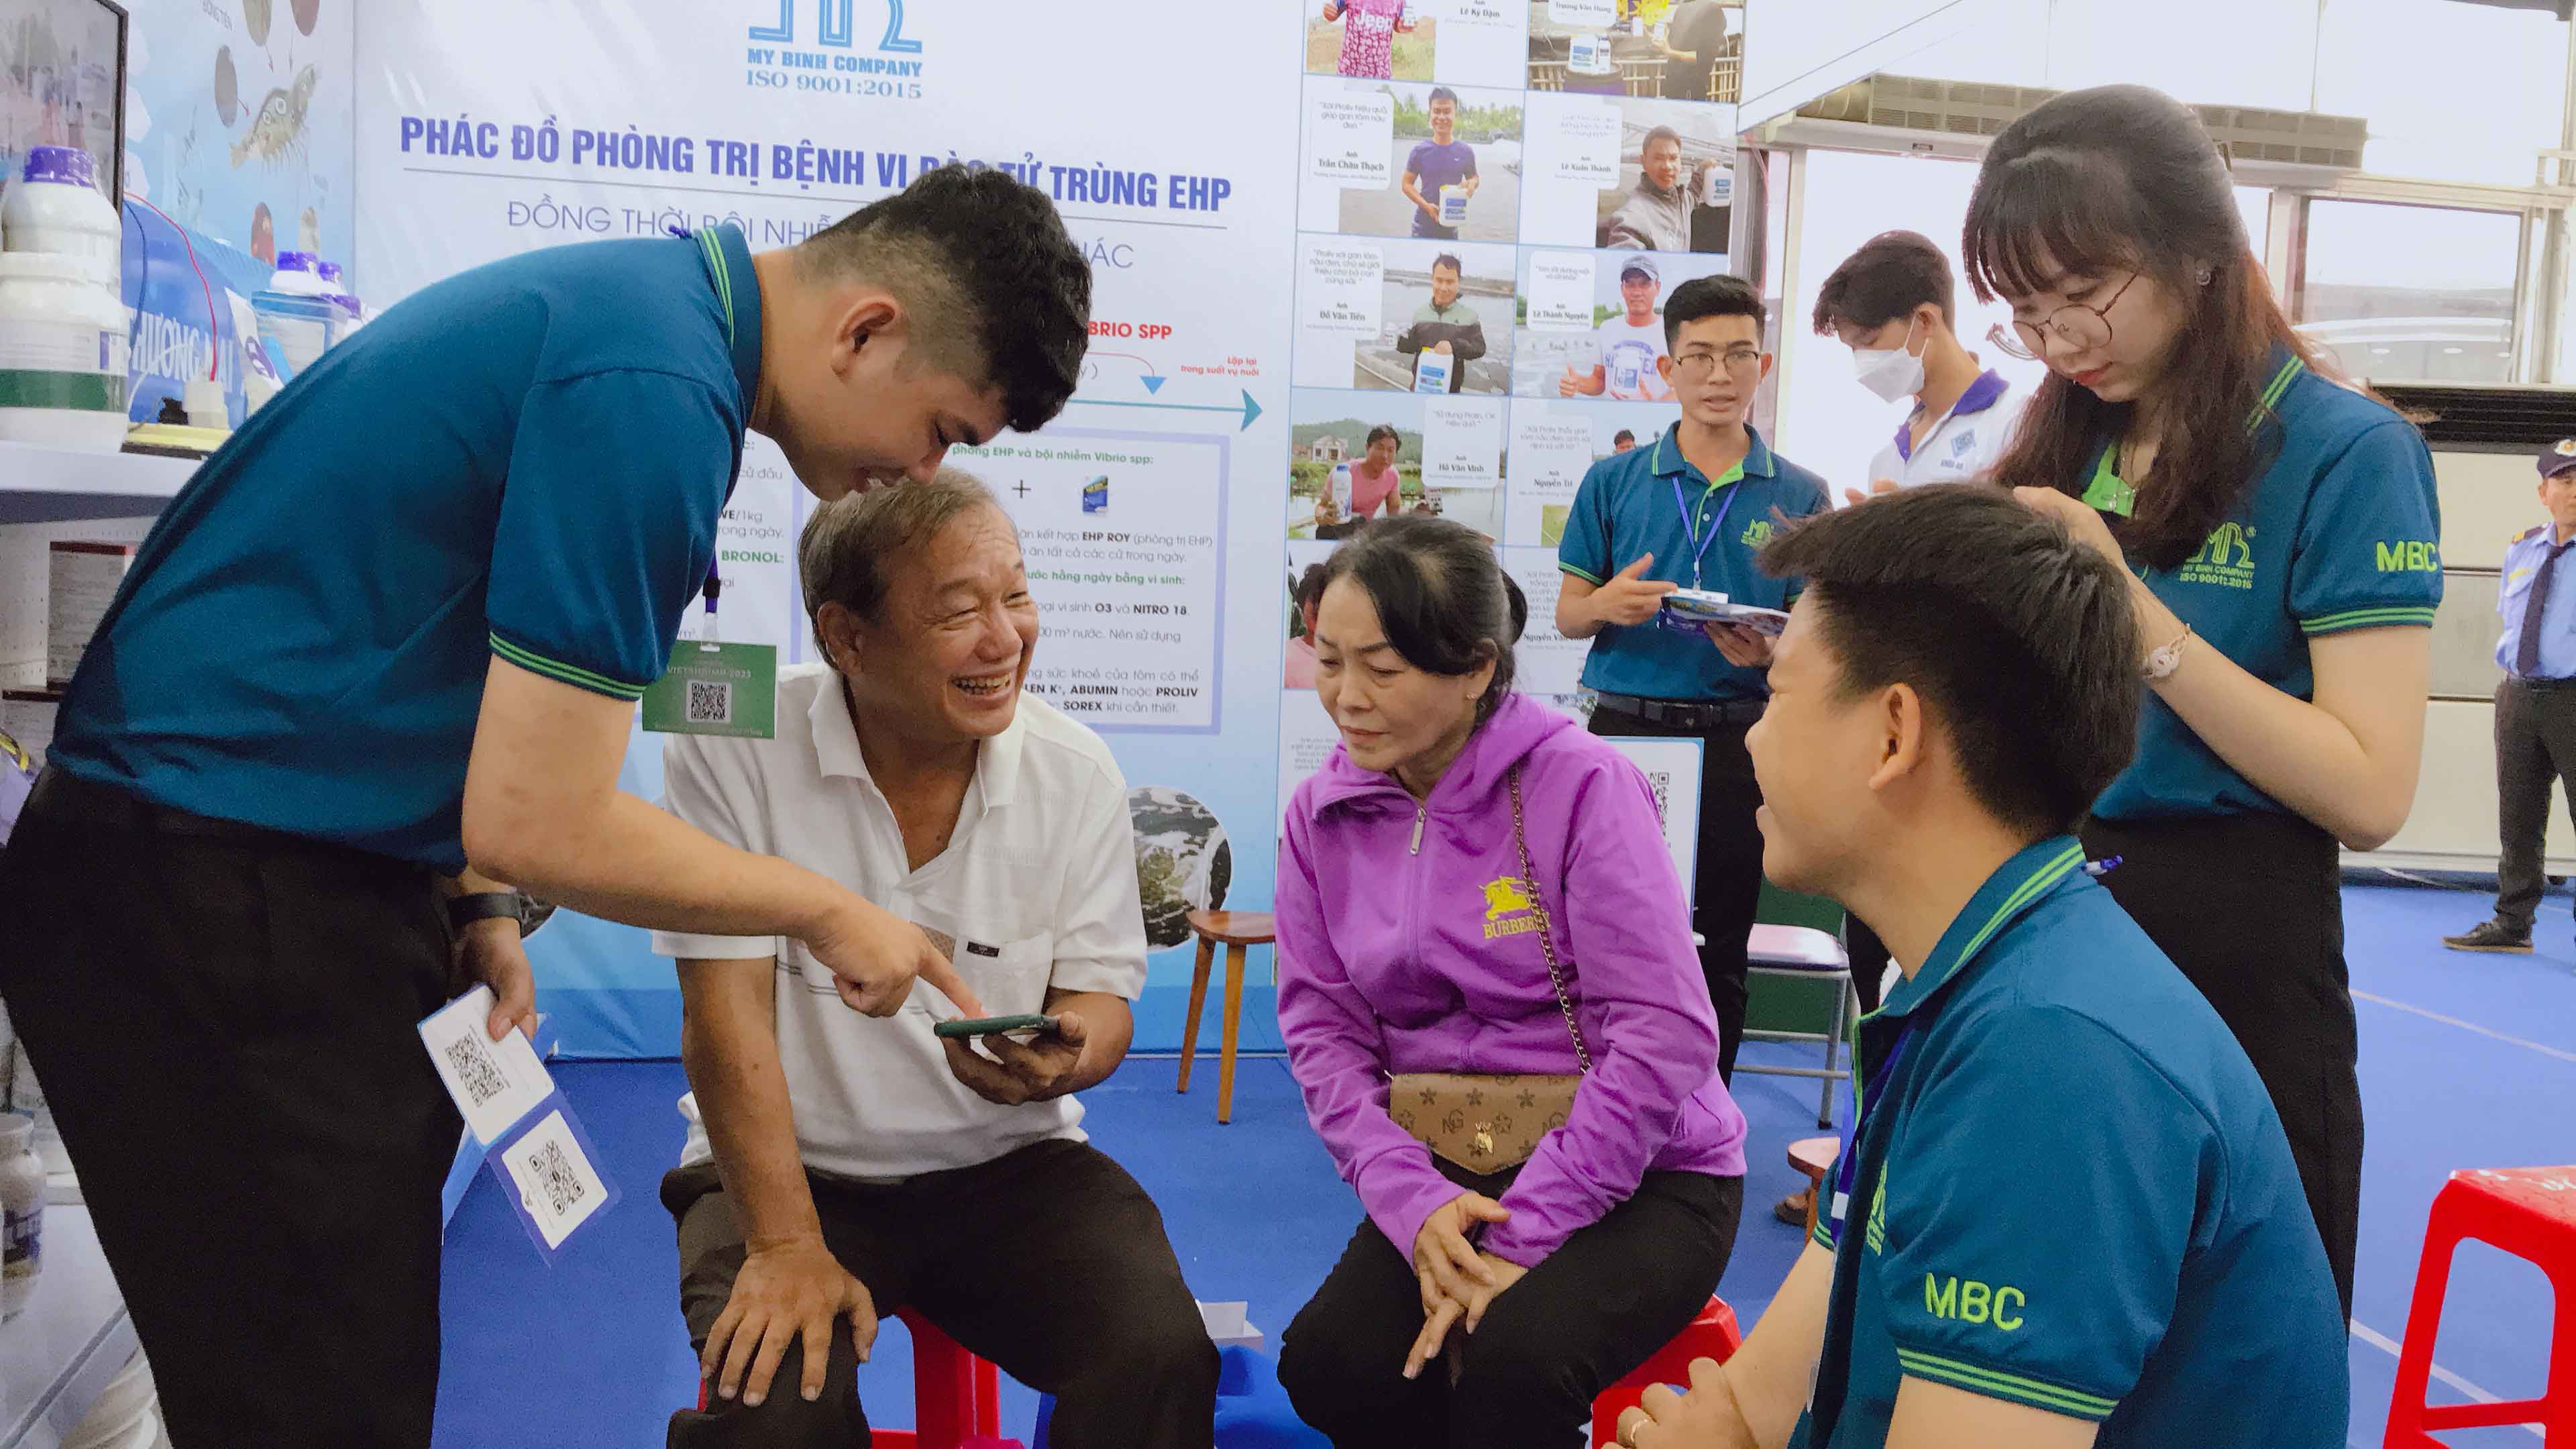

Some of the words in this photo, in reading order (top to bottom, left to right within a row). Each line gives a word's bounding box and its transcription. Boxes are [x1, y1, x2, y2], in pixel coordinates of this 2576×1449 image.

[1353, 9, 1394, 28] Jeep
[747, 48, 775, 66] MY
[782, 50, 828, 70] BINH
[834, 54, 922, 78] COMPANY
[747, 69, 789, 89] ISO
[796, 74, 922, 99] 9001:2015
[401, 113, 499, 159] PHÁC
[511, 113, 559, 163] ĐỒ
[572, 123, 694, 173] PHÒNG
[706, 139, 759, 186] TRỊ
[772, 138, 864, 190] BỆNH
[876, 152, 906, 189] VI
[1049, 160, 1158, 208] TRÙNG
[1169, 174, 1232, 212] EHP
[507, 193, 612, 233] ĐỒNG
[1138, 323, 1173, 340] SPP
[127, 310, 200, 383] HƯƠNG
[993, 447, 1014, 458] EHP
[1018, 448, 1032, 459] và
[1095, 452, 1127, 464] Vibrio
[718, 526, 747, 538] rong
[1082, 531, 1104, 541] EHP
[1107, 531, 1131, 543] ROY
[721, 549, 784, 564] BRONOL:
[2375, 540, 2437, 573] MBC
[1027, 570, 1048, 581] ước
[1095, 602, 1112, 613] O3
[1133, 604, 1169, 616] NITRO
[1071, 686, 1118, 696] ABUMIN
[1156, 687, 1199, 697] PROLIV
[1063, 700, 1103, 711] SOREX
[1483, 914, 1547, 940] BURBER
[1924, 1272, 2026, 1332] MBC
